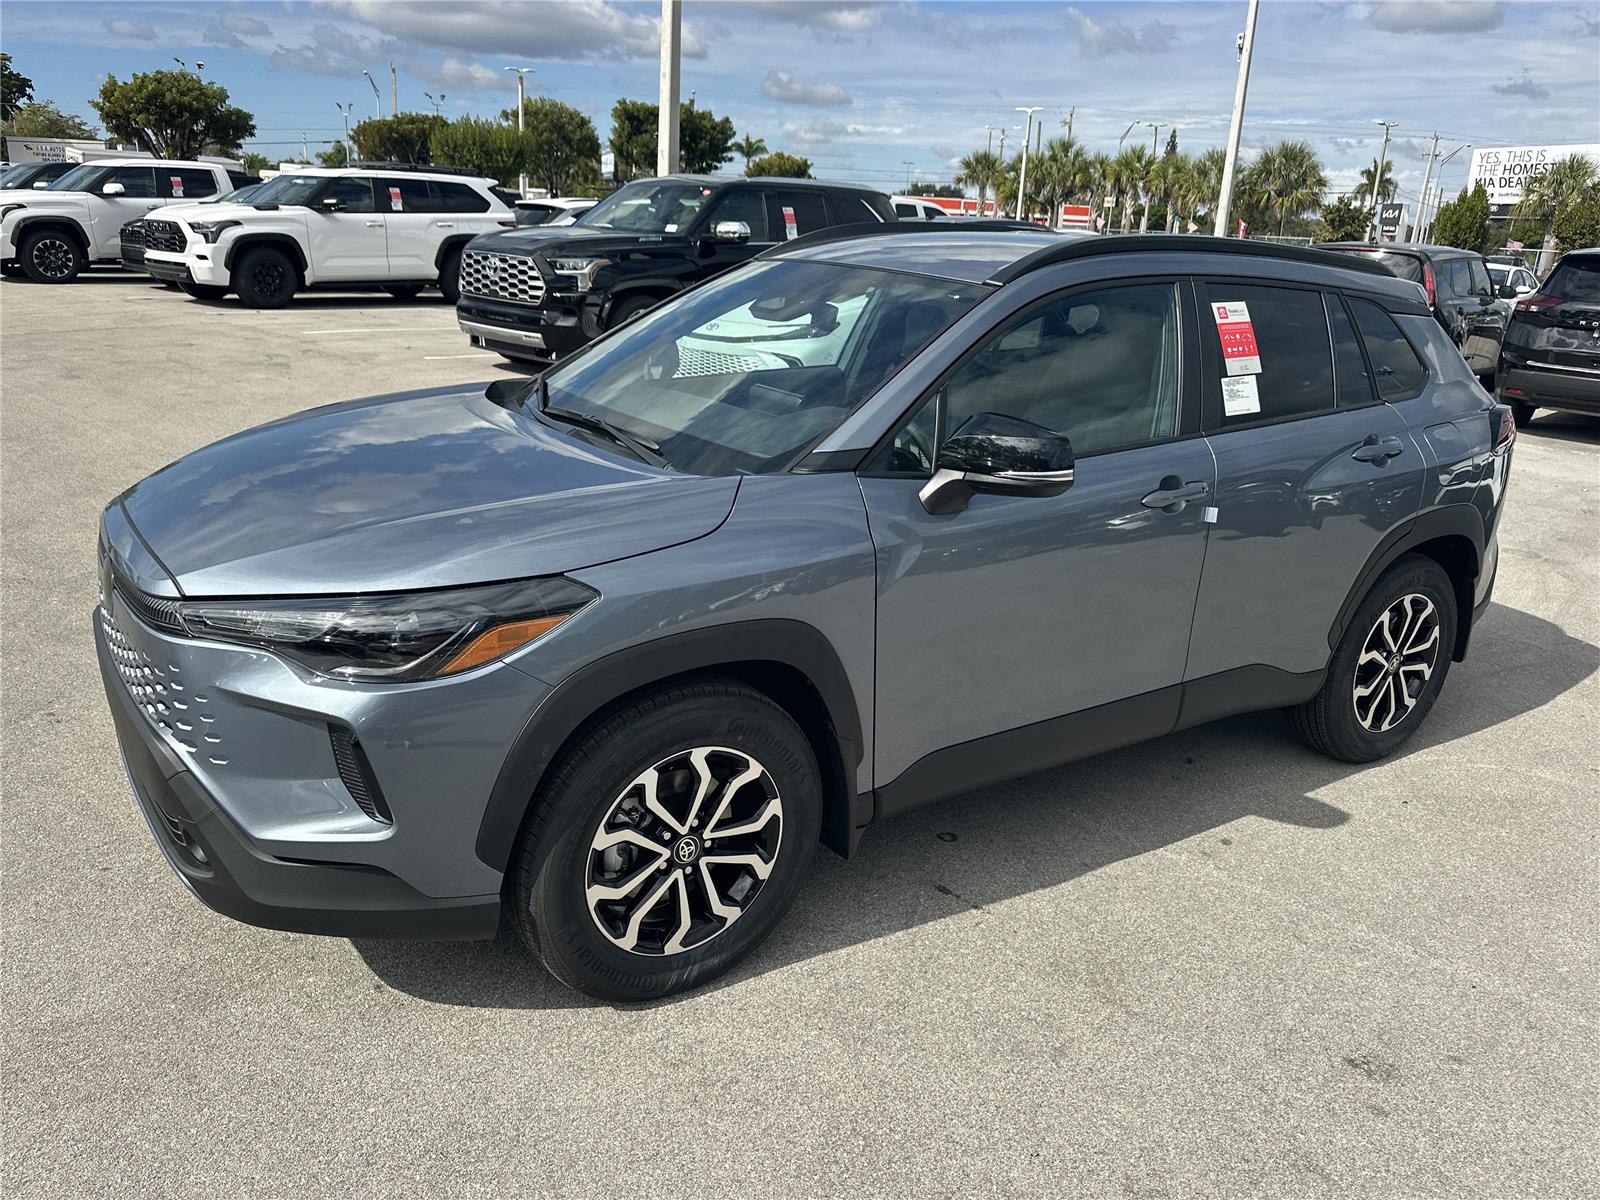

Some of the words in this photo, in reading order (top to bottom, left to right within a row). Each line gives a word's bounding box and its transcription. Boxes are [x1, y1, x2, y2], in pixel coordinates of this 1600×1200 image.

[1480, 151, 1502, 165] YES,
[1508, 150, 1533, 163] THIS
[1536, 149, 1547, 162] IS
[1478, 164, 1500, 176] THE
[1502, 163, 1558, 176] HOMEST
[1475, 177, 1495, 188] KIA
[1499, 177, 1528, 188] DEAL
